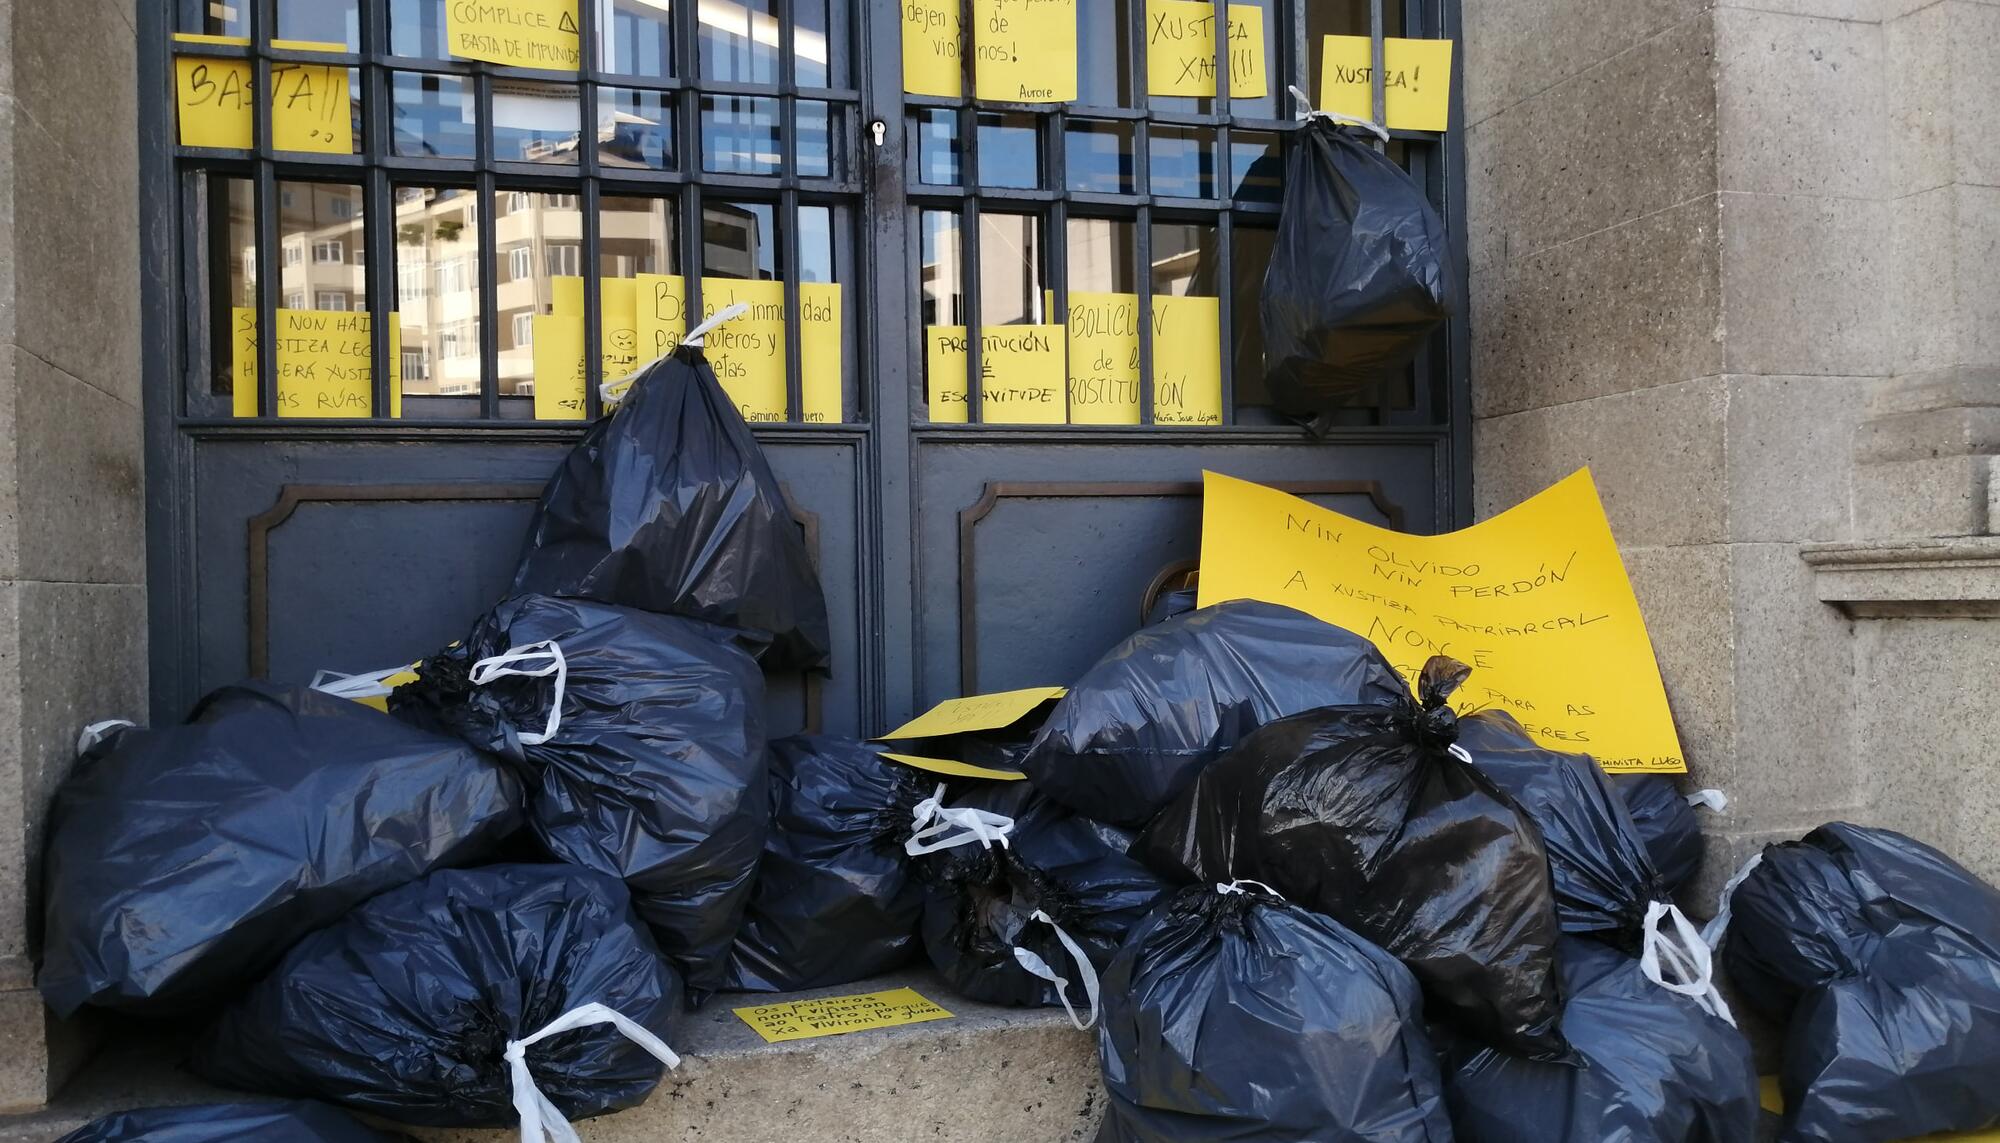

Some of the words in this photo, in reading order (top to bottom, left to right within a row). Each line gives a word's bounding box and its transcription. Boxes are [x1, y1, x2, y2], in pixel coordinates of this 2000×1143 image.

[907, 4, 946, 33] dejen
[989, 11, 1009, 33] de
[1151, 11, 1248, 45] XUSTZA
[460, 33, 501, 55] BASTA
[505, 39, 523, 58] DE
[1019, 84, 1052, 98] Aurore
[289, 315, 328, 332] NON
[245, 336, 330, 353] XSTIZA
[767, 333, 777, 357] y
[1093, 348, 1114, 371] de
[316, 388, 369, 409] RÚAS
[741, 404, 780, 422] Camino
[1283, 570, 1308, 591] A
[1449, 550, 1577, 598] PERDÓN
[1367, 615, 1452, 656] NON
[1482, 687, 1537, 712] PARA
[1566, 703, 1596, 716] AS
